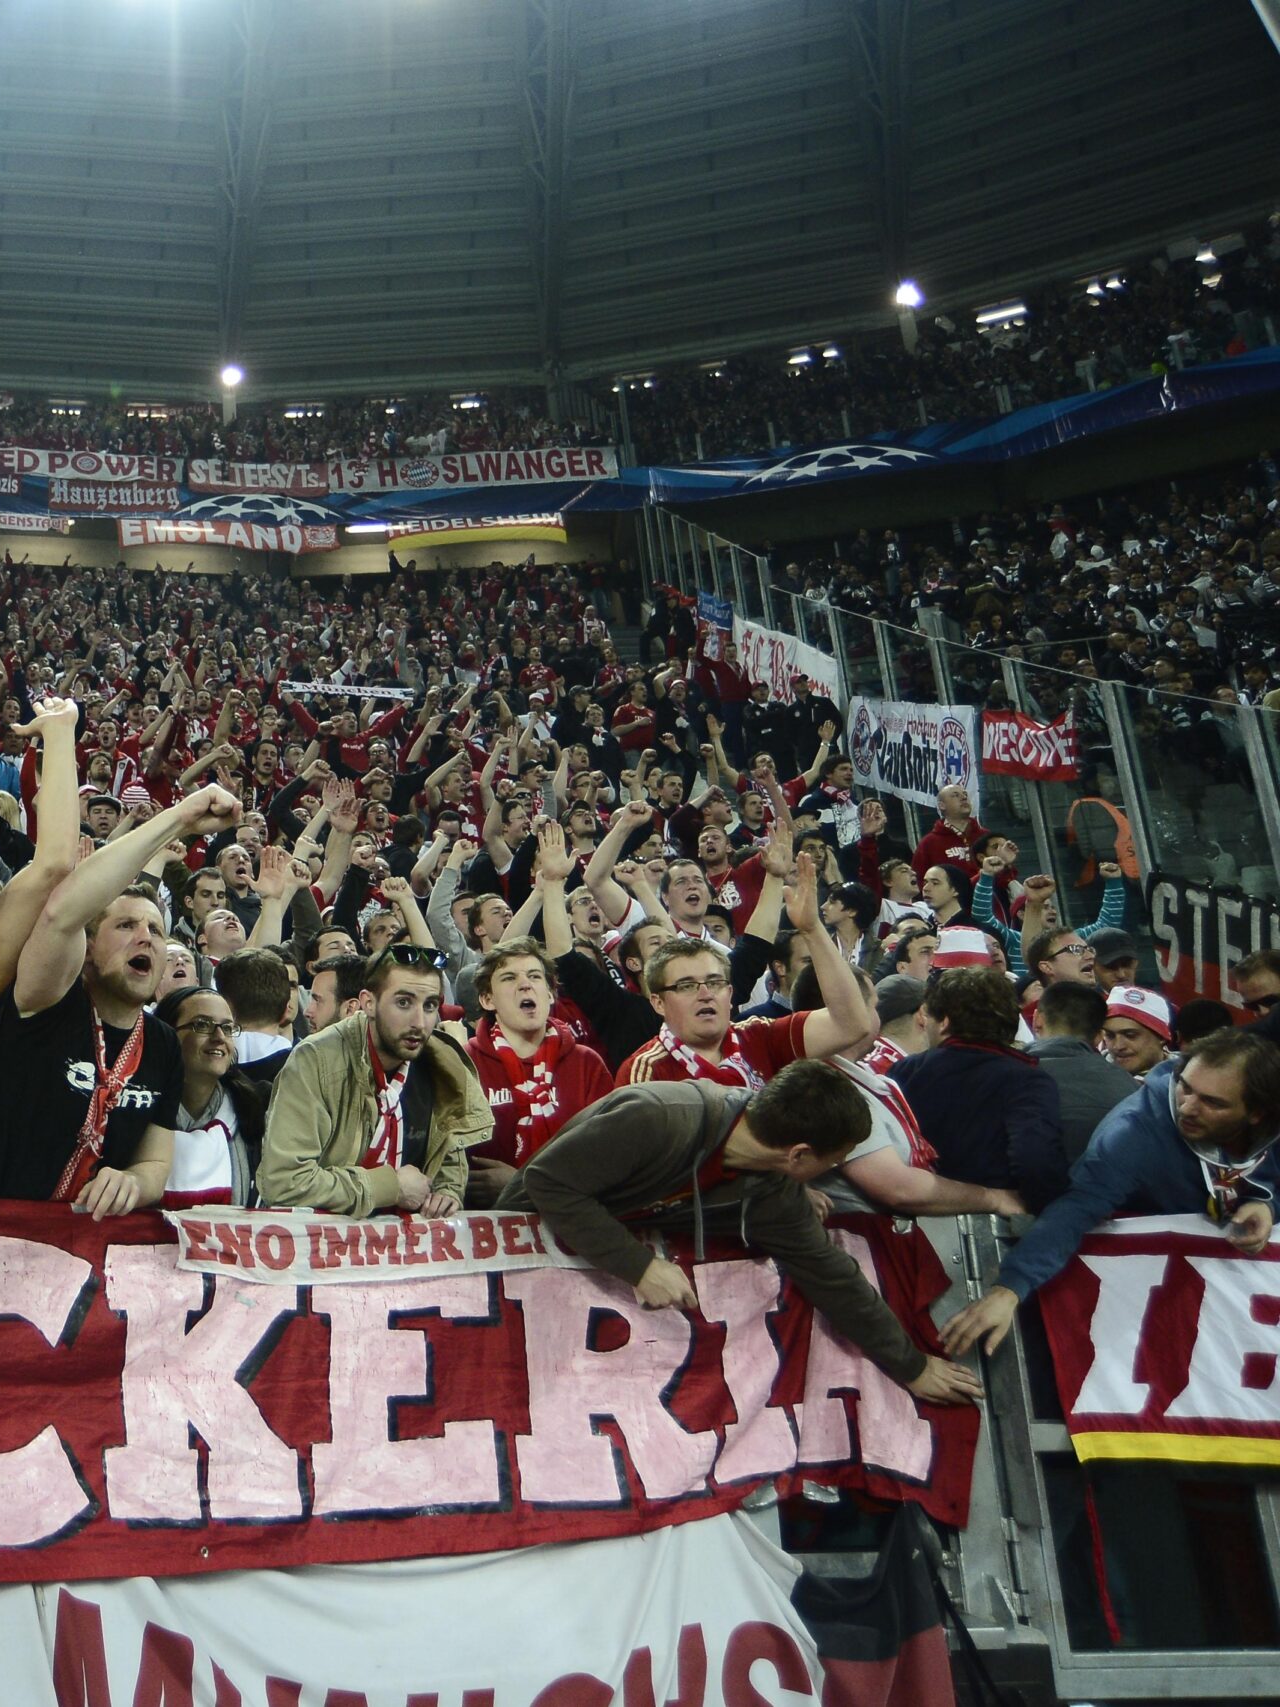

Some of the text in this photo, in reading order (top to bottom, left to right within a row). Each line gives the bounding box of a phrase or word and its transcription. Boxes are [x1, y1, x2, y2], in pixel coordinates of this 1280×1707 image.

[48, 452, 177, 482] POWER
[123, 519, 302, 553] EMSLAND
[388, 512, 564, 537] HEIDELSHEIM
[181, 1219, 295, 1270] ENO
[305, 1216, 463, 1269] IMMER
